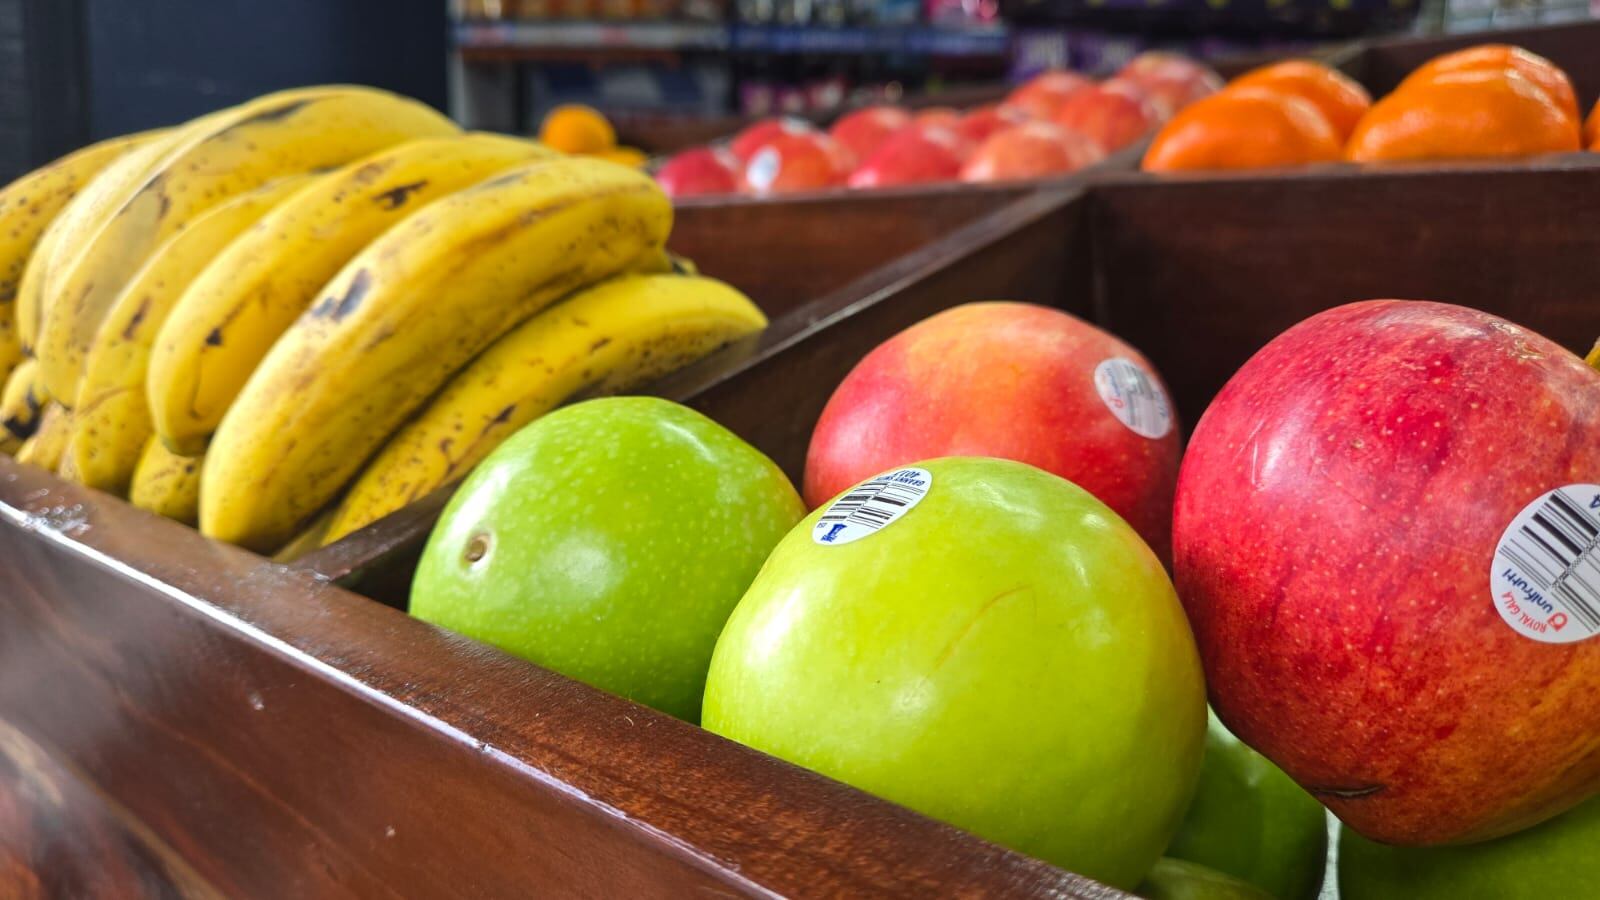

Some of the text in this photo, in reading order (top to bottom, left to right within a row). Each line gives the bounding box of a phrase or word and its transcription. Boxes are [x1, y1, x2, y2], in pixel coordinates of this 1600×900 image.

[893, 477, 925, 487] GRANNY
[1502, 591, 1547, 633] ROYAL GALA
